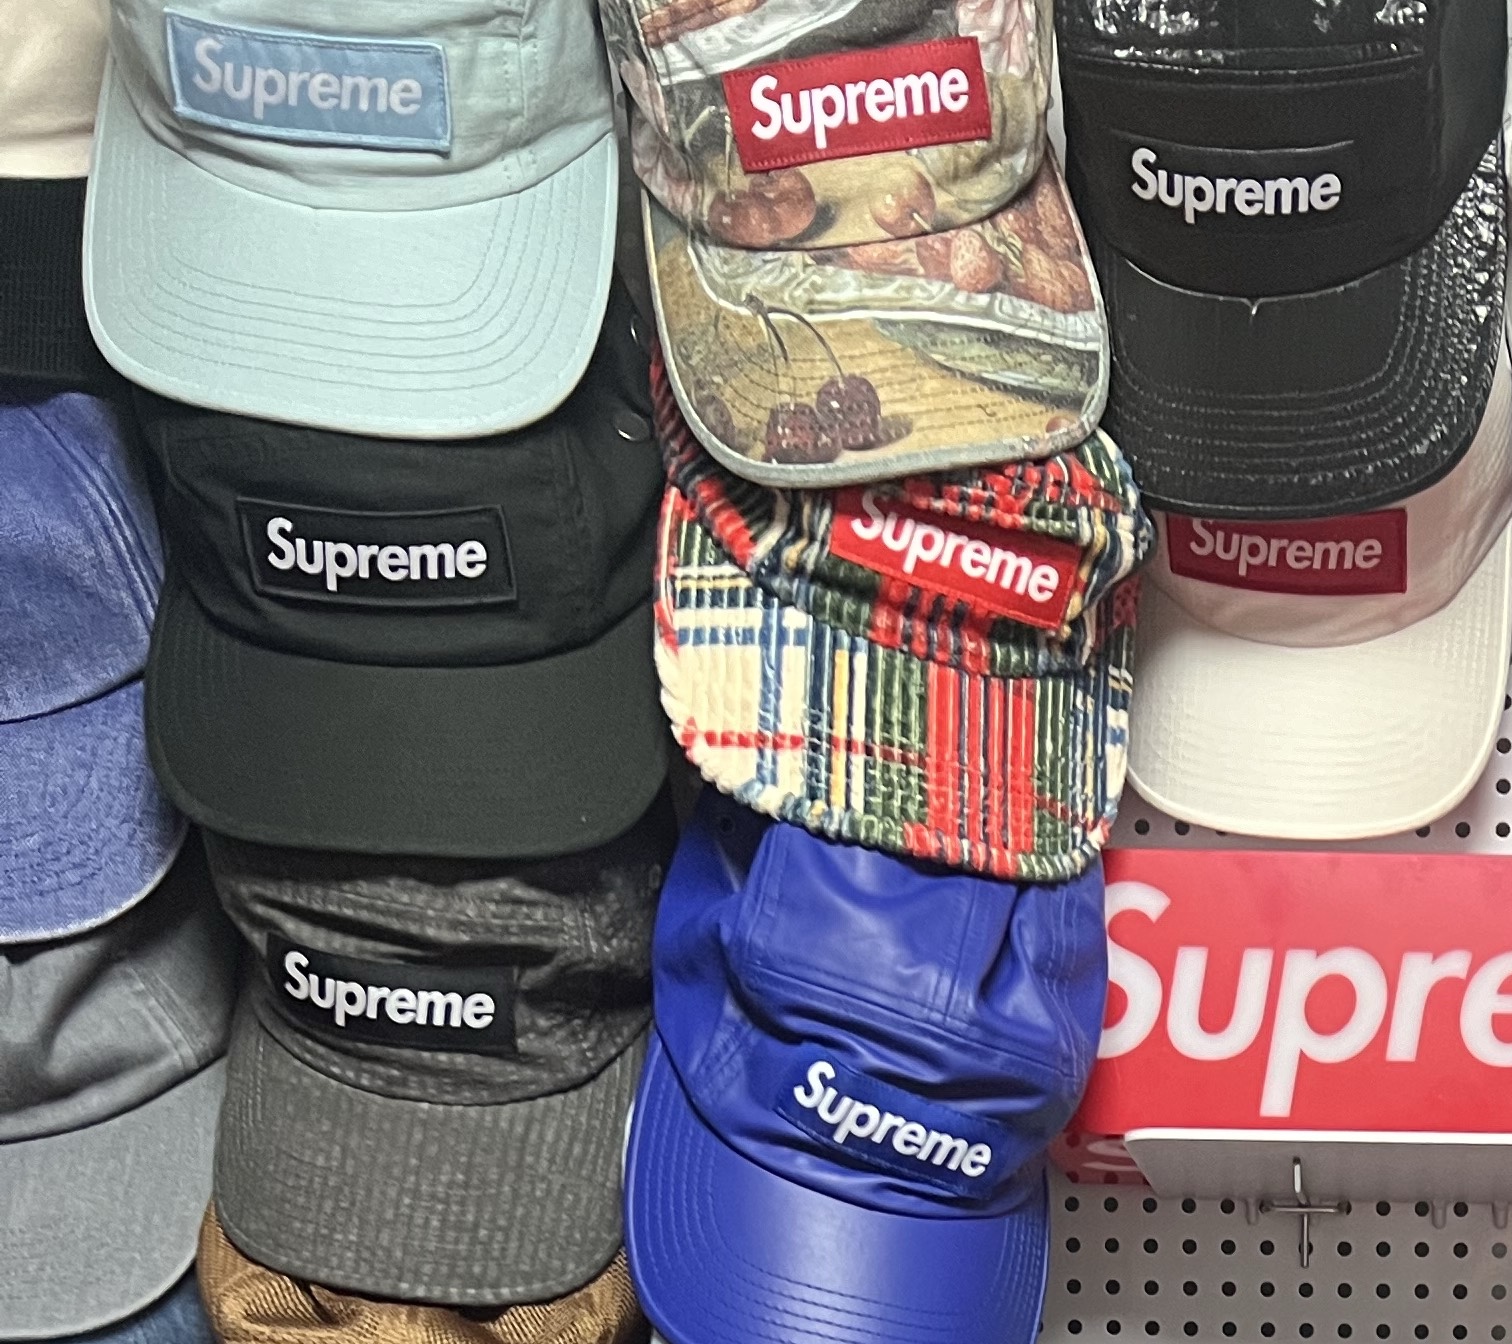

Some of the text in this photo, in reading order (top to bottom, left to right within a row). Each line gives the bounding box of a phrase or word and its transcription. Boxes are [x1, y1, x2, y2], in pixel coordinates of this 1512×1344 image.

[193, 35, 423, 120] Supreme
[750, 66, 970, 148] Supreme
[1130, 148, 1343, 223] Supreme
[266, 516, 488, 592] Supreme
[851, 490, 1060, 603] Supreme
[1189, 520, 1383, 575] Supreme
[284, 951, 496, 1027] Supreme
[793, 1061, 992, 1178] Supreme
